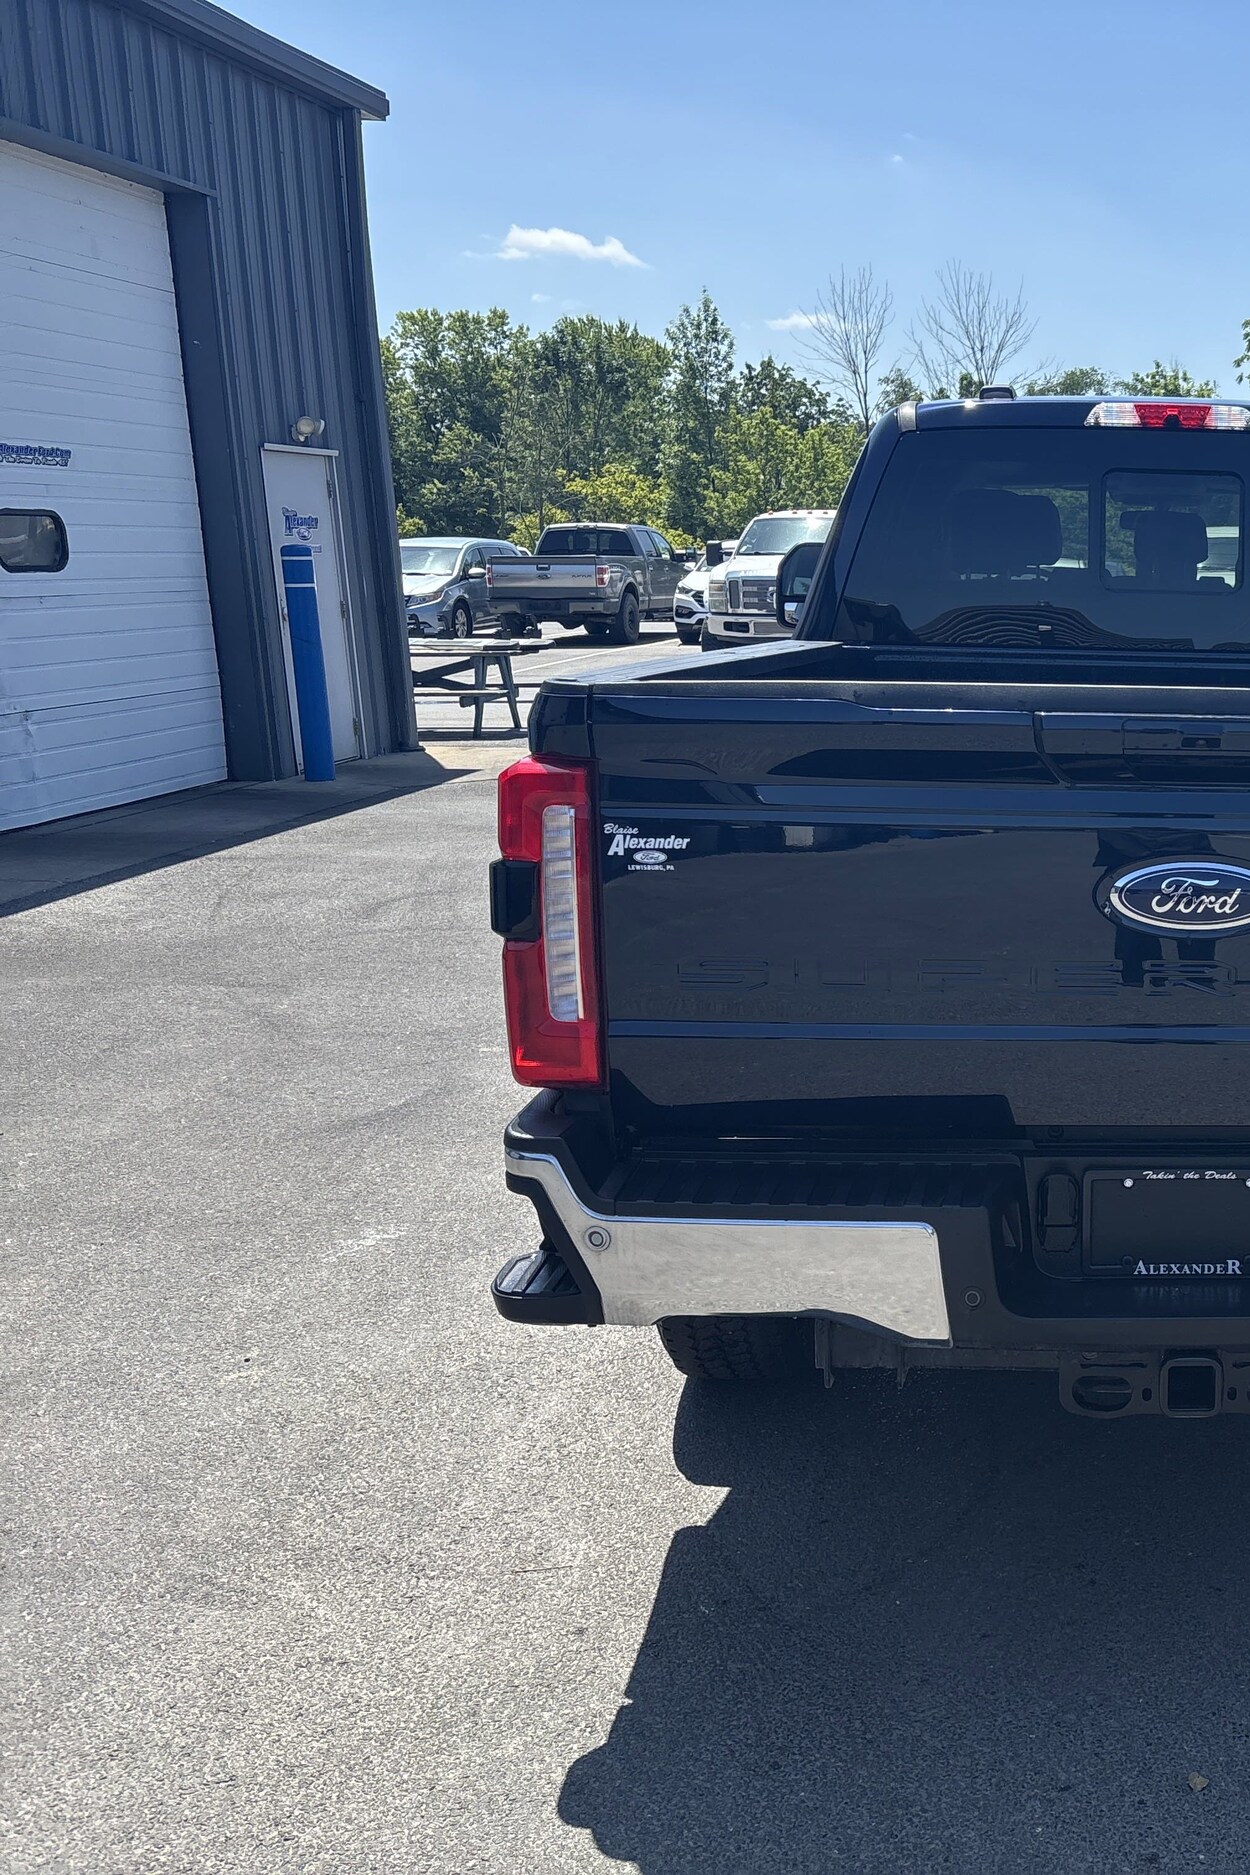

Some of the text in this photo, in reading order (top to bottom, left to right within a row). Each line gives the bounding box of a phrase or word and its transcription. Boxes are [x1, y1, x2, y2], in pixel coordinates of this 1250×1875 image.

[603, 823, 639, 834] Blaise
[607, 834, 691, 856] Alexander
[1151, 876, 1240, 914] Ford
[1142, 1170, 1238, 1180] Takin' the Deals
[1133, 1259, 1243, 1275] ALEXANDER
